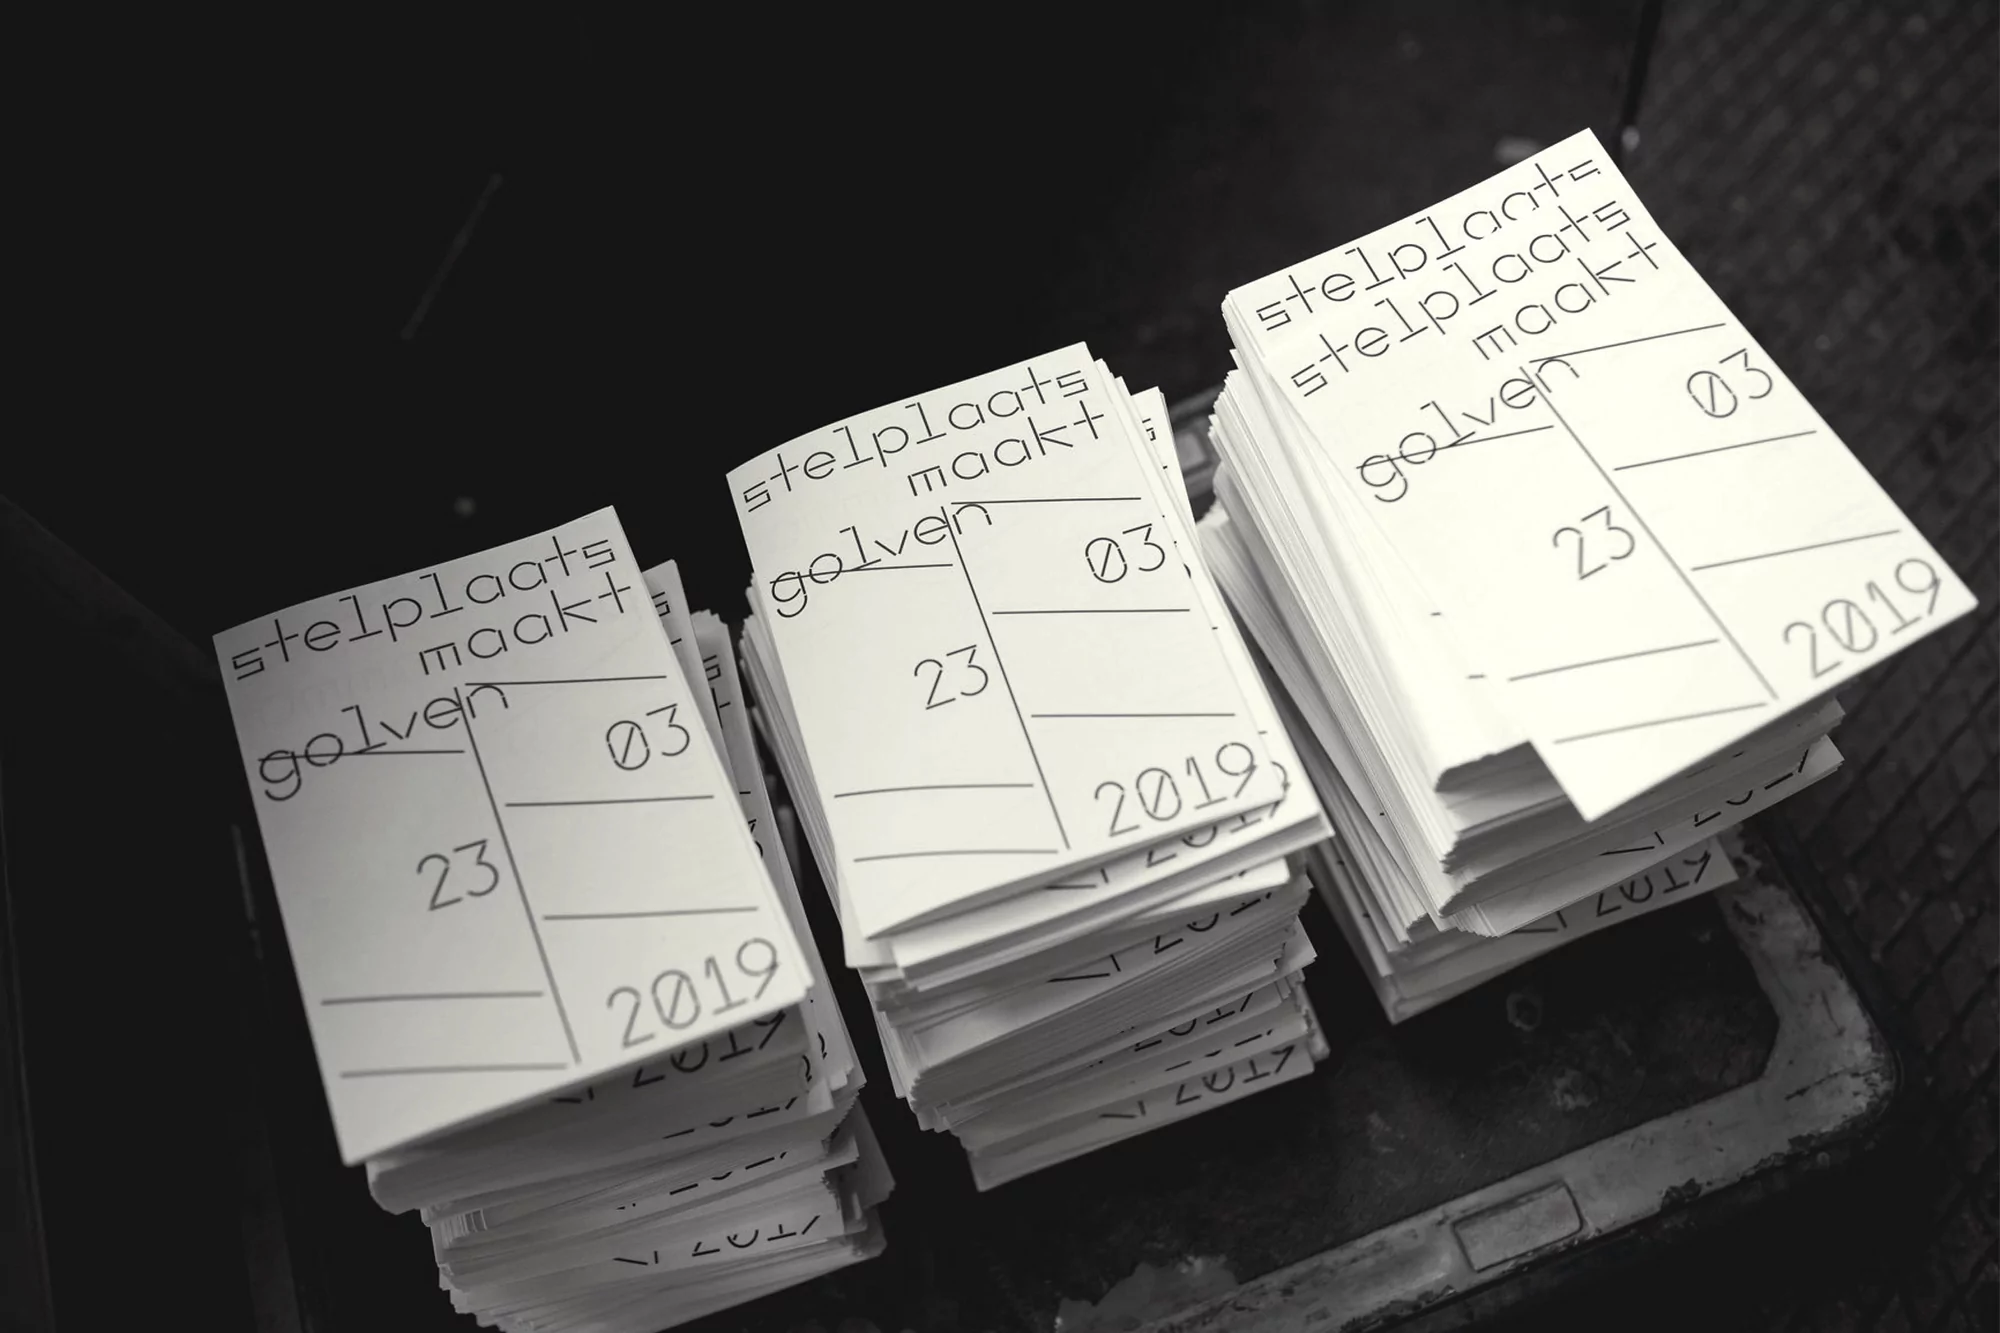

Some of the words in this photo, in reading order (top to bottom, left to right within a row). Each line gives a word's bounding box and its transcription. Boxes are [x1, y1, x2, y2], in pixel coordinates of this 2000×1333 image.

[1290, 200, 1631, 397] stelplaats
[1471, 231, 1658, 361] maakt
[1360, 358, 1580, 503] golven
[1687, 347, 1773, 419] 03
[743, 366, 1089, 513] stelplaats
[907, 399, 1105, 497] maakt
[771, 503, 993, 618] golven
[1085, 523, 1166, 584] 03
[1552, 505, 1635, 580] 23
[231, 535, 616, 681] stelplaats
[418, 571, 632, 676] maakt
[1783, 557, 1942, 679] 2019
[914, 644, 989, 710] 23
[258, 684, 510, 802] golven
[605, 703, 691, 771] 03
[1094, 742, 1258, 838] 2019
[417, 839, 499, 912] 23
[606, 937, 780, 1050] 2019
